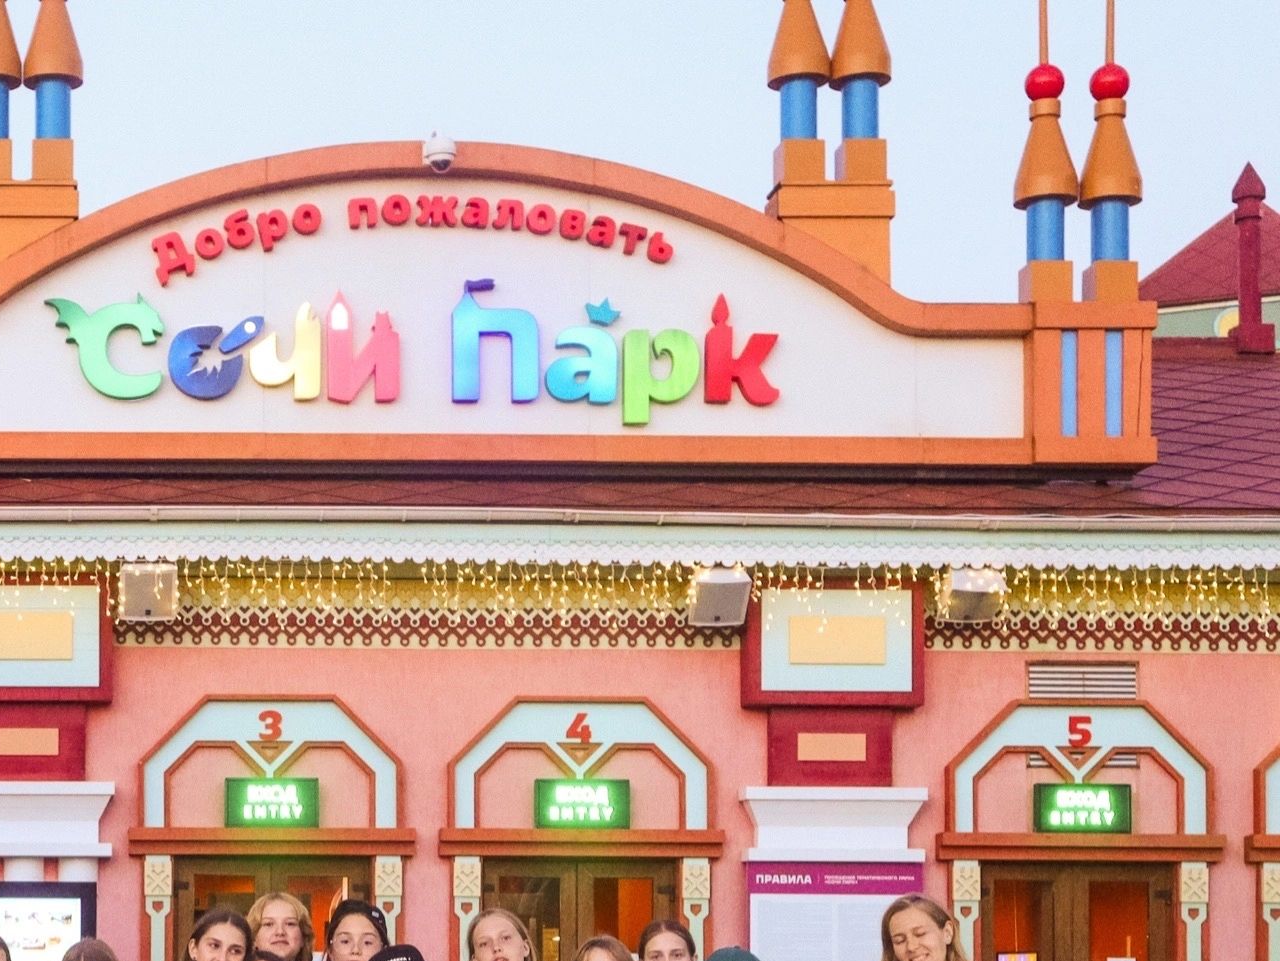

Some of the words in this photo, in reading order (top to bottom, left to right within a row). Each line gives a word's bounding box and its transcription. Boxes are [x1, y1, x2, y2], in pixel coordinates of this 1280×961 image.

[151, 203, 322, 288] Добро
[347, 193, 675, 265] пожаловать
[45, 290, 400, 404] Сочи
[451, 278, 781, 427] Парк
[258, 710, 283, 741] 3
[566, 713, 592, 744] 4
[1068, 716, 1092, 748] 5
[243, 804, 303, 820] ENTRY
[549, 806, 614, 821] ENTRY
[1050, 810, 1114, 825] ENTRY
[755, 874, 813, 885] ПРАВИЛА
